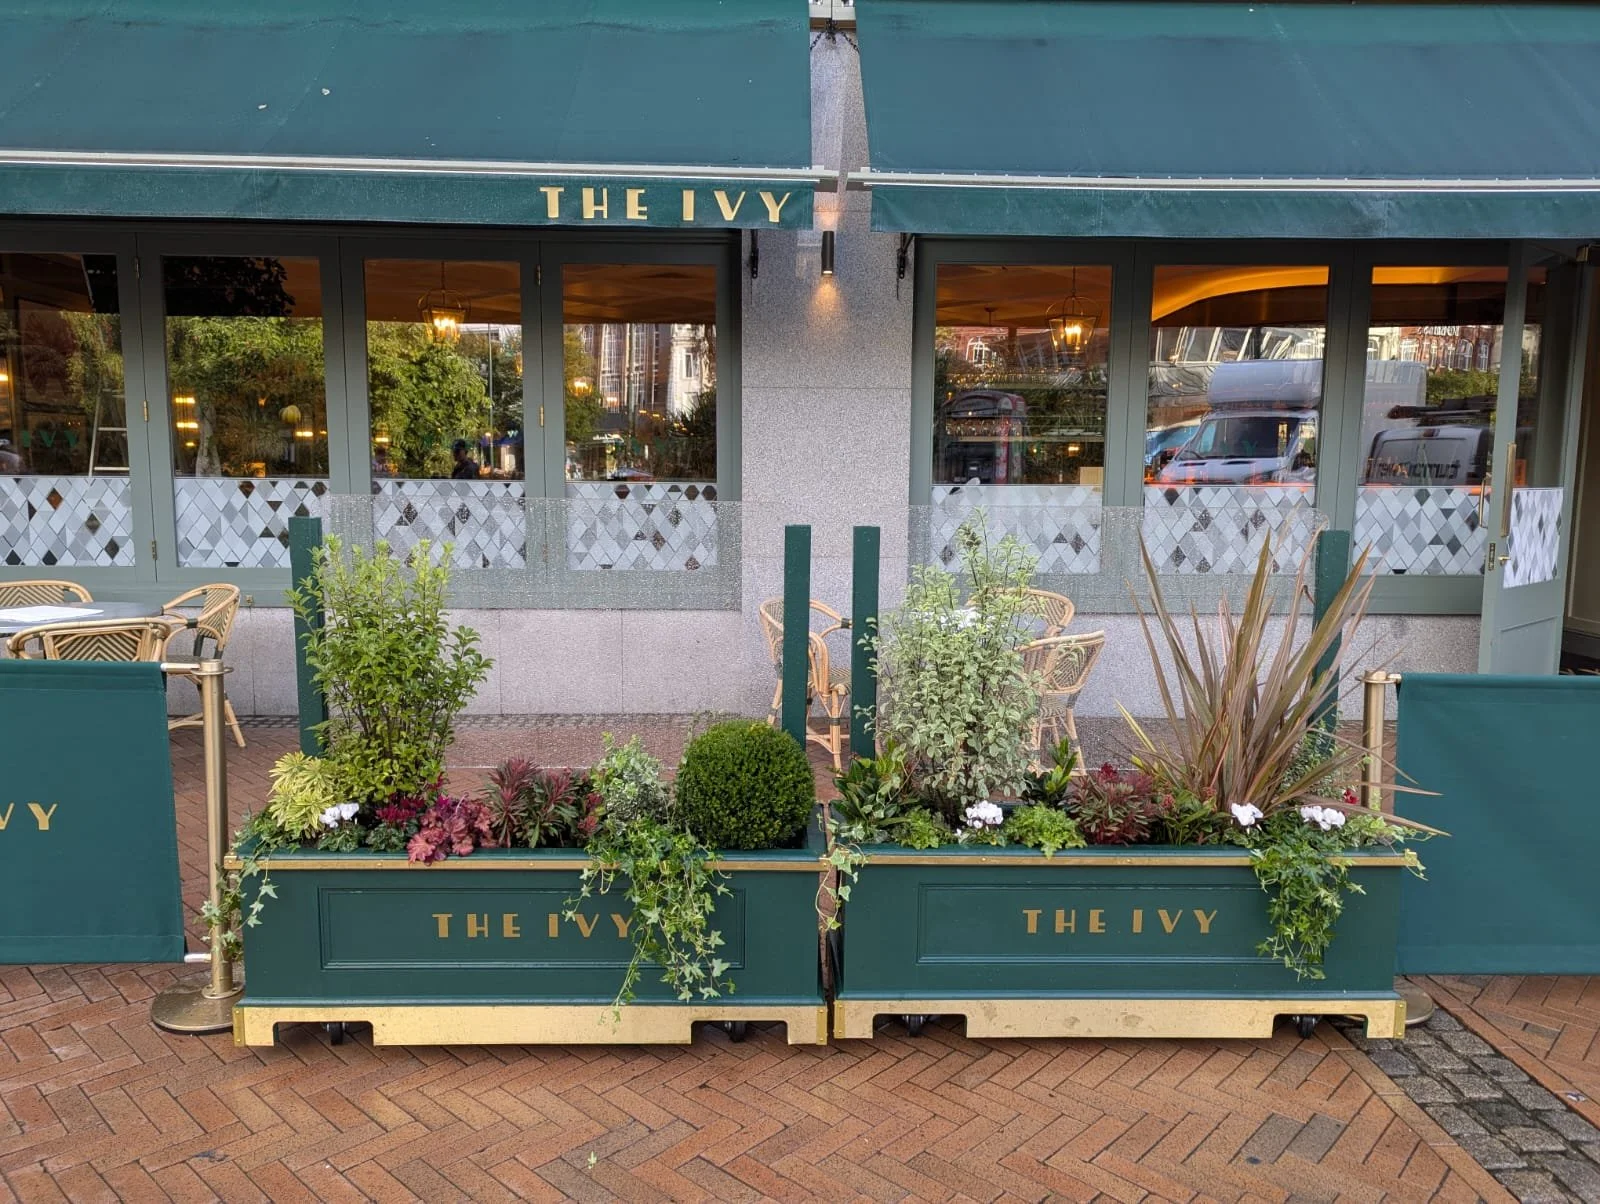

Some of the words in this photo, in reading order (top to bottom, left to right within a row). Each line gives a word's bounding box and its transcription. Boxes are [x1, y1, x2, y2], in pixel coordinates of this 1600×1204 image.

[540, 186, 647, 220] THE
[682, 190, 790, 223] IVY
[432, 912, 520, 939] THE
[547, 912, 633, 939] IVY
[1023, 908, 1106, 934] THE
[1131, 908, 1218, 934] IVY
